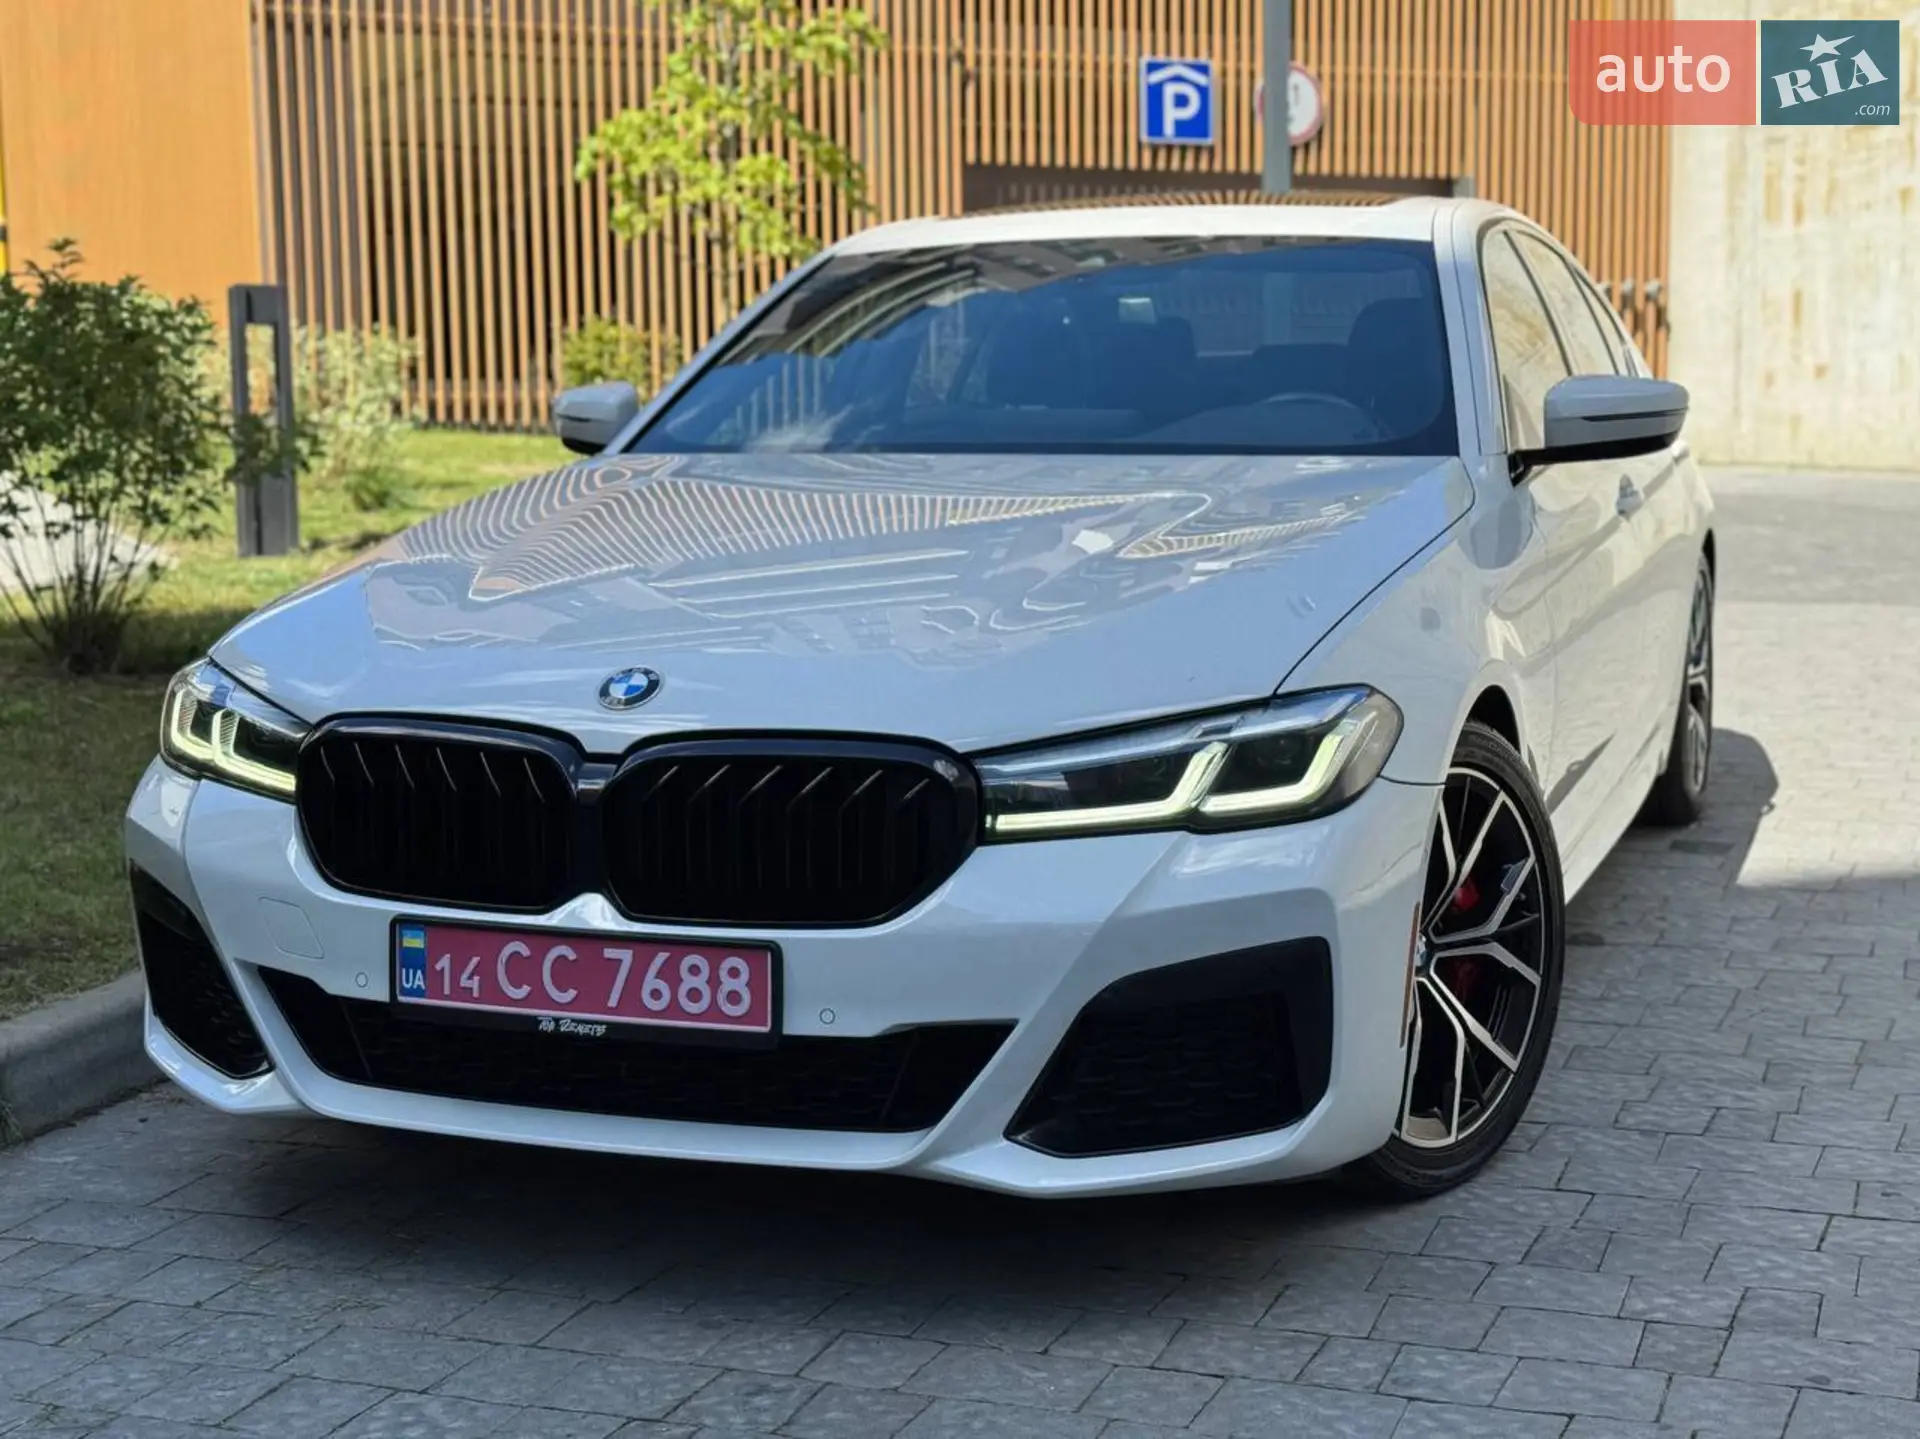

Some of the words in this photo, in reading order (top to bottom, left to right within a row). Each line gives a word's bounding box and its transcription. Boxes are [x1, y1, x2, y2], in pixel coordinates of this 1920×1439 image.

[1163, 82, 1201, 138] P
[402, 968, 425, 990] UA
[434, 953, 482, 998] 14
[602, 948, 752, 1018] 7688
